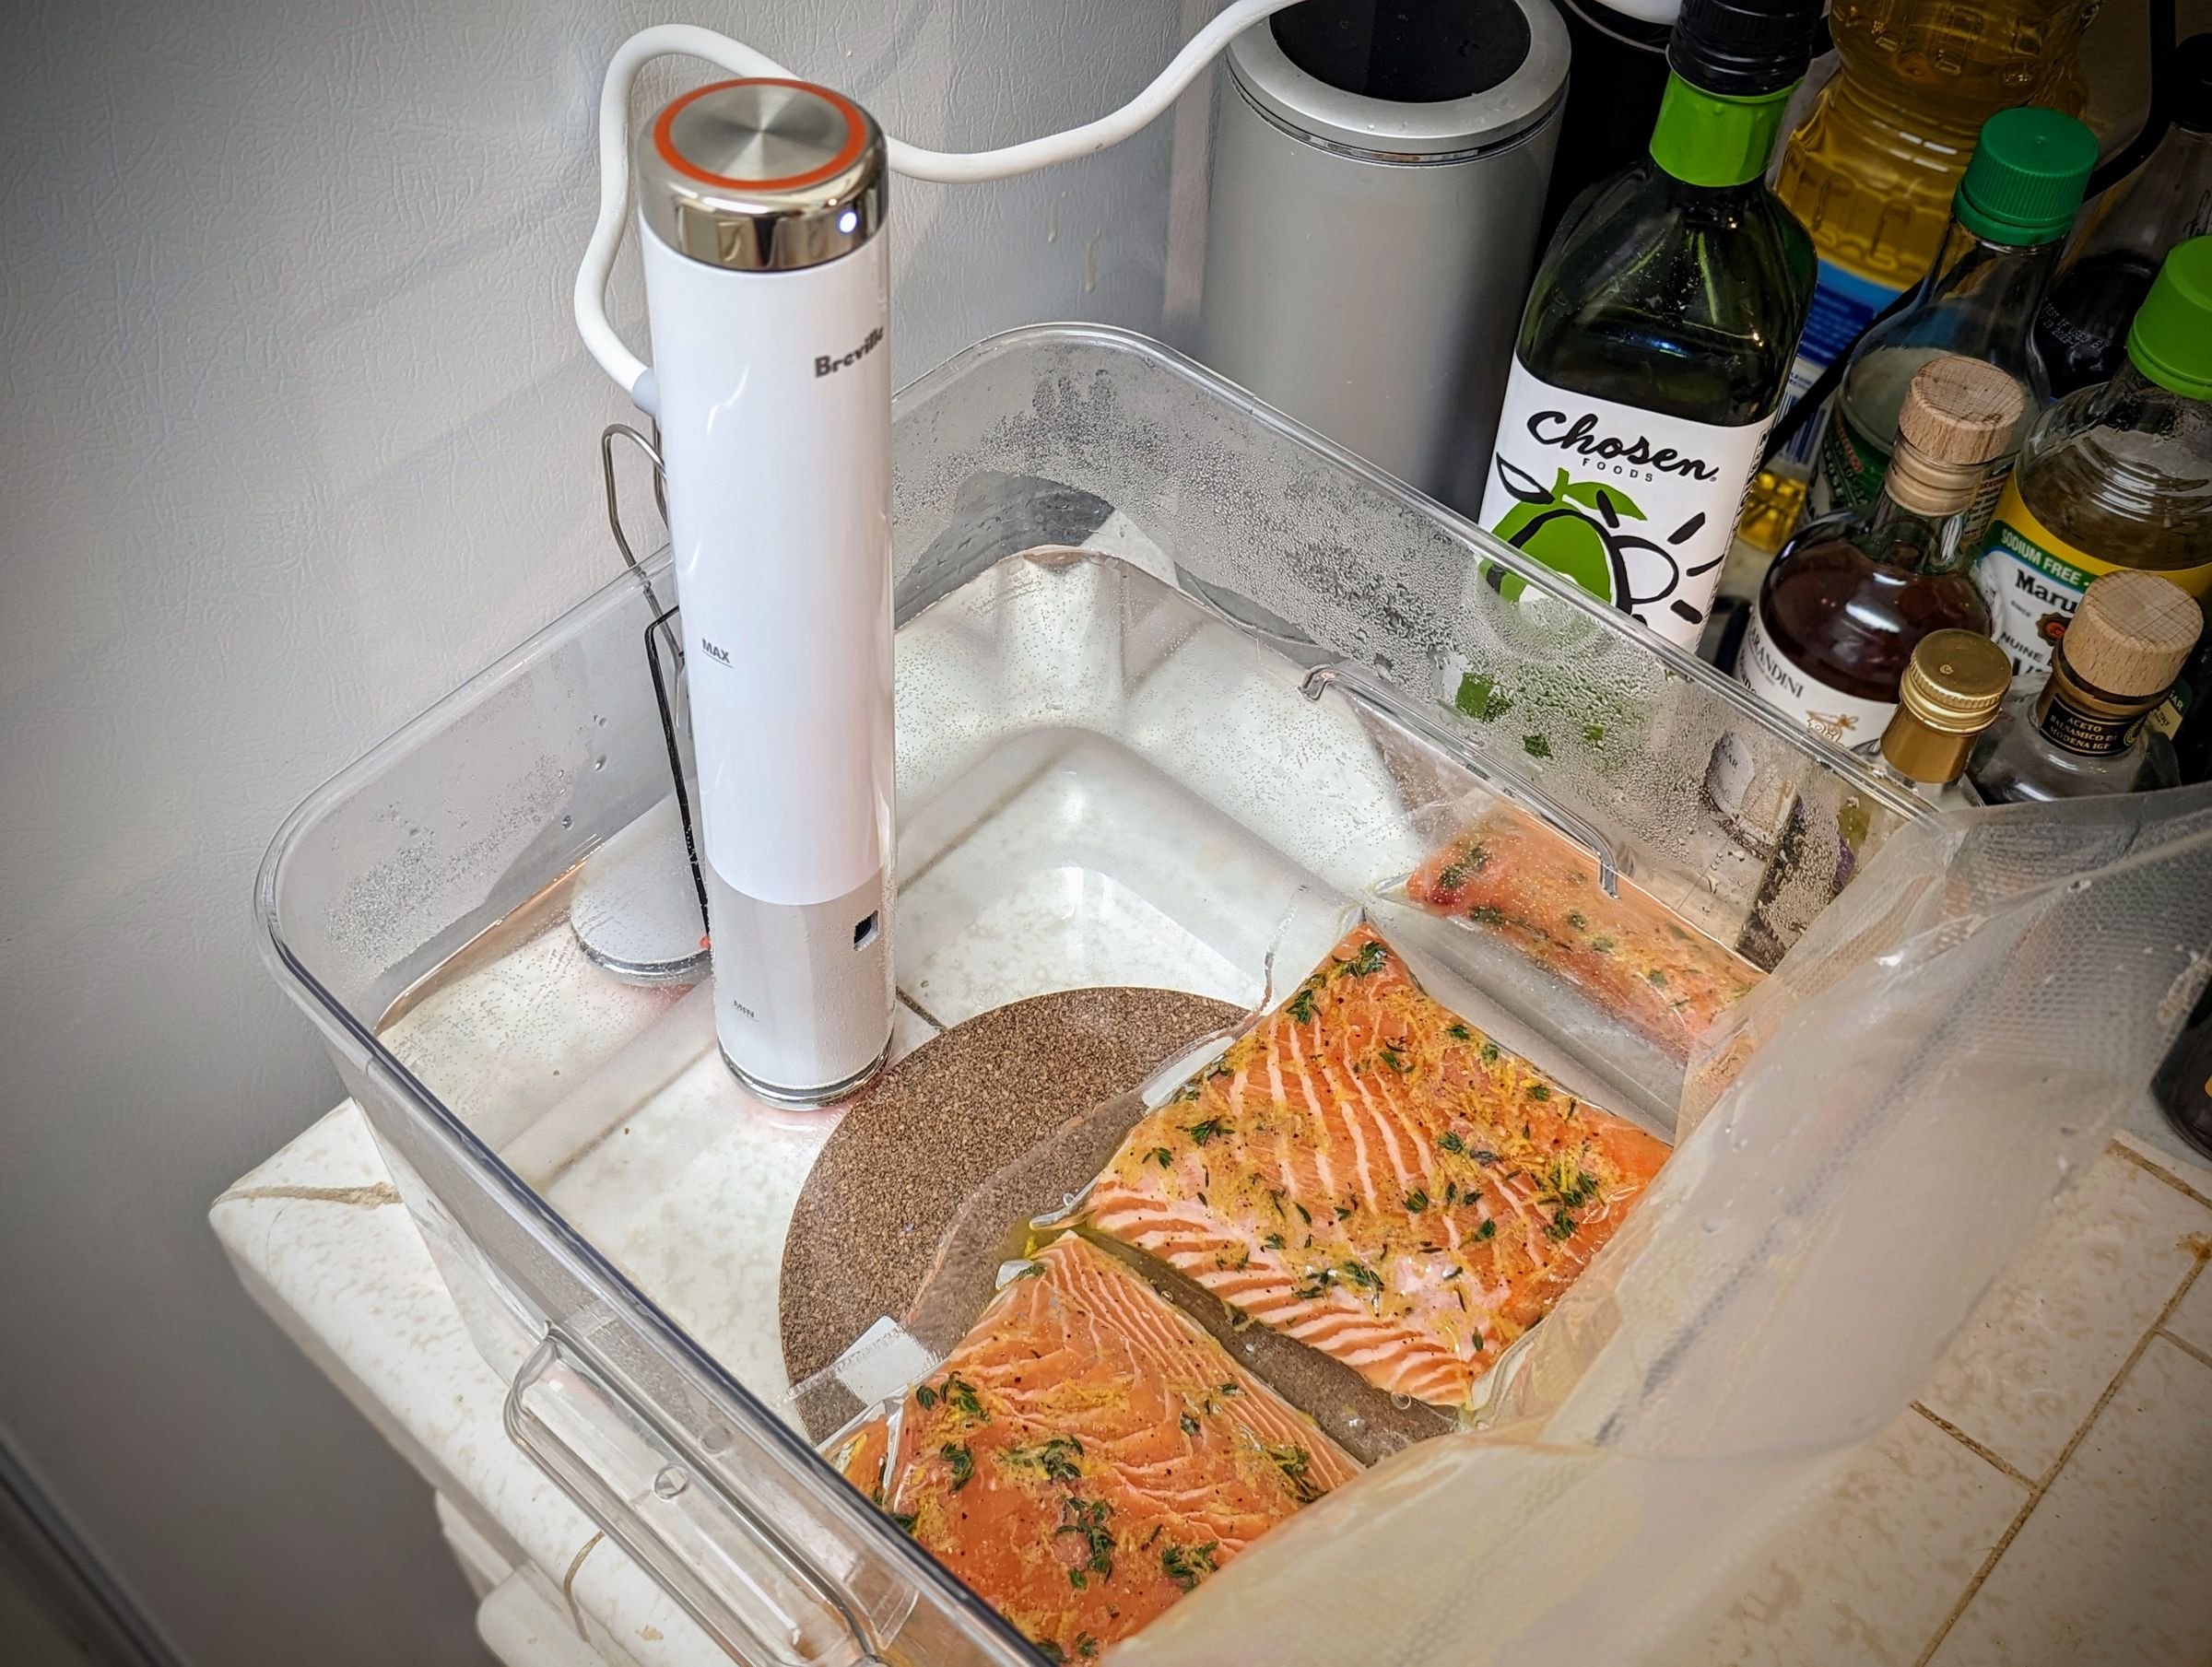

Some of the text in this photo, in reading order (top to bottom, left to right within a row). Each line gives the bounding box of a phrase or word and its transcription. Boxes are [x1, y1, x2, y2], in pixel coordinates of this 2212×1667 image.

[1526, 411, 1719, 481] Chosen
[1583, 457, 1653, 483] FOODS
[2001, 528, 2042, 565] SODIUM
[2042, 557, 2082, 585] FREE
[2015, 569, 2078, 615] Maru
[701, 638, 731, 663] MAX
[1997, 631, 2043, 663] NUINE
[2050, 714, 2104, 742] BALSAMICO
[2050, 726, 2090, 749] MODENA
[2066, 716, 2102, 733] ACETO
